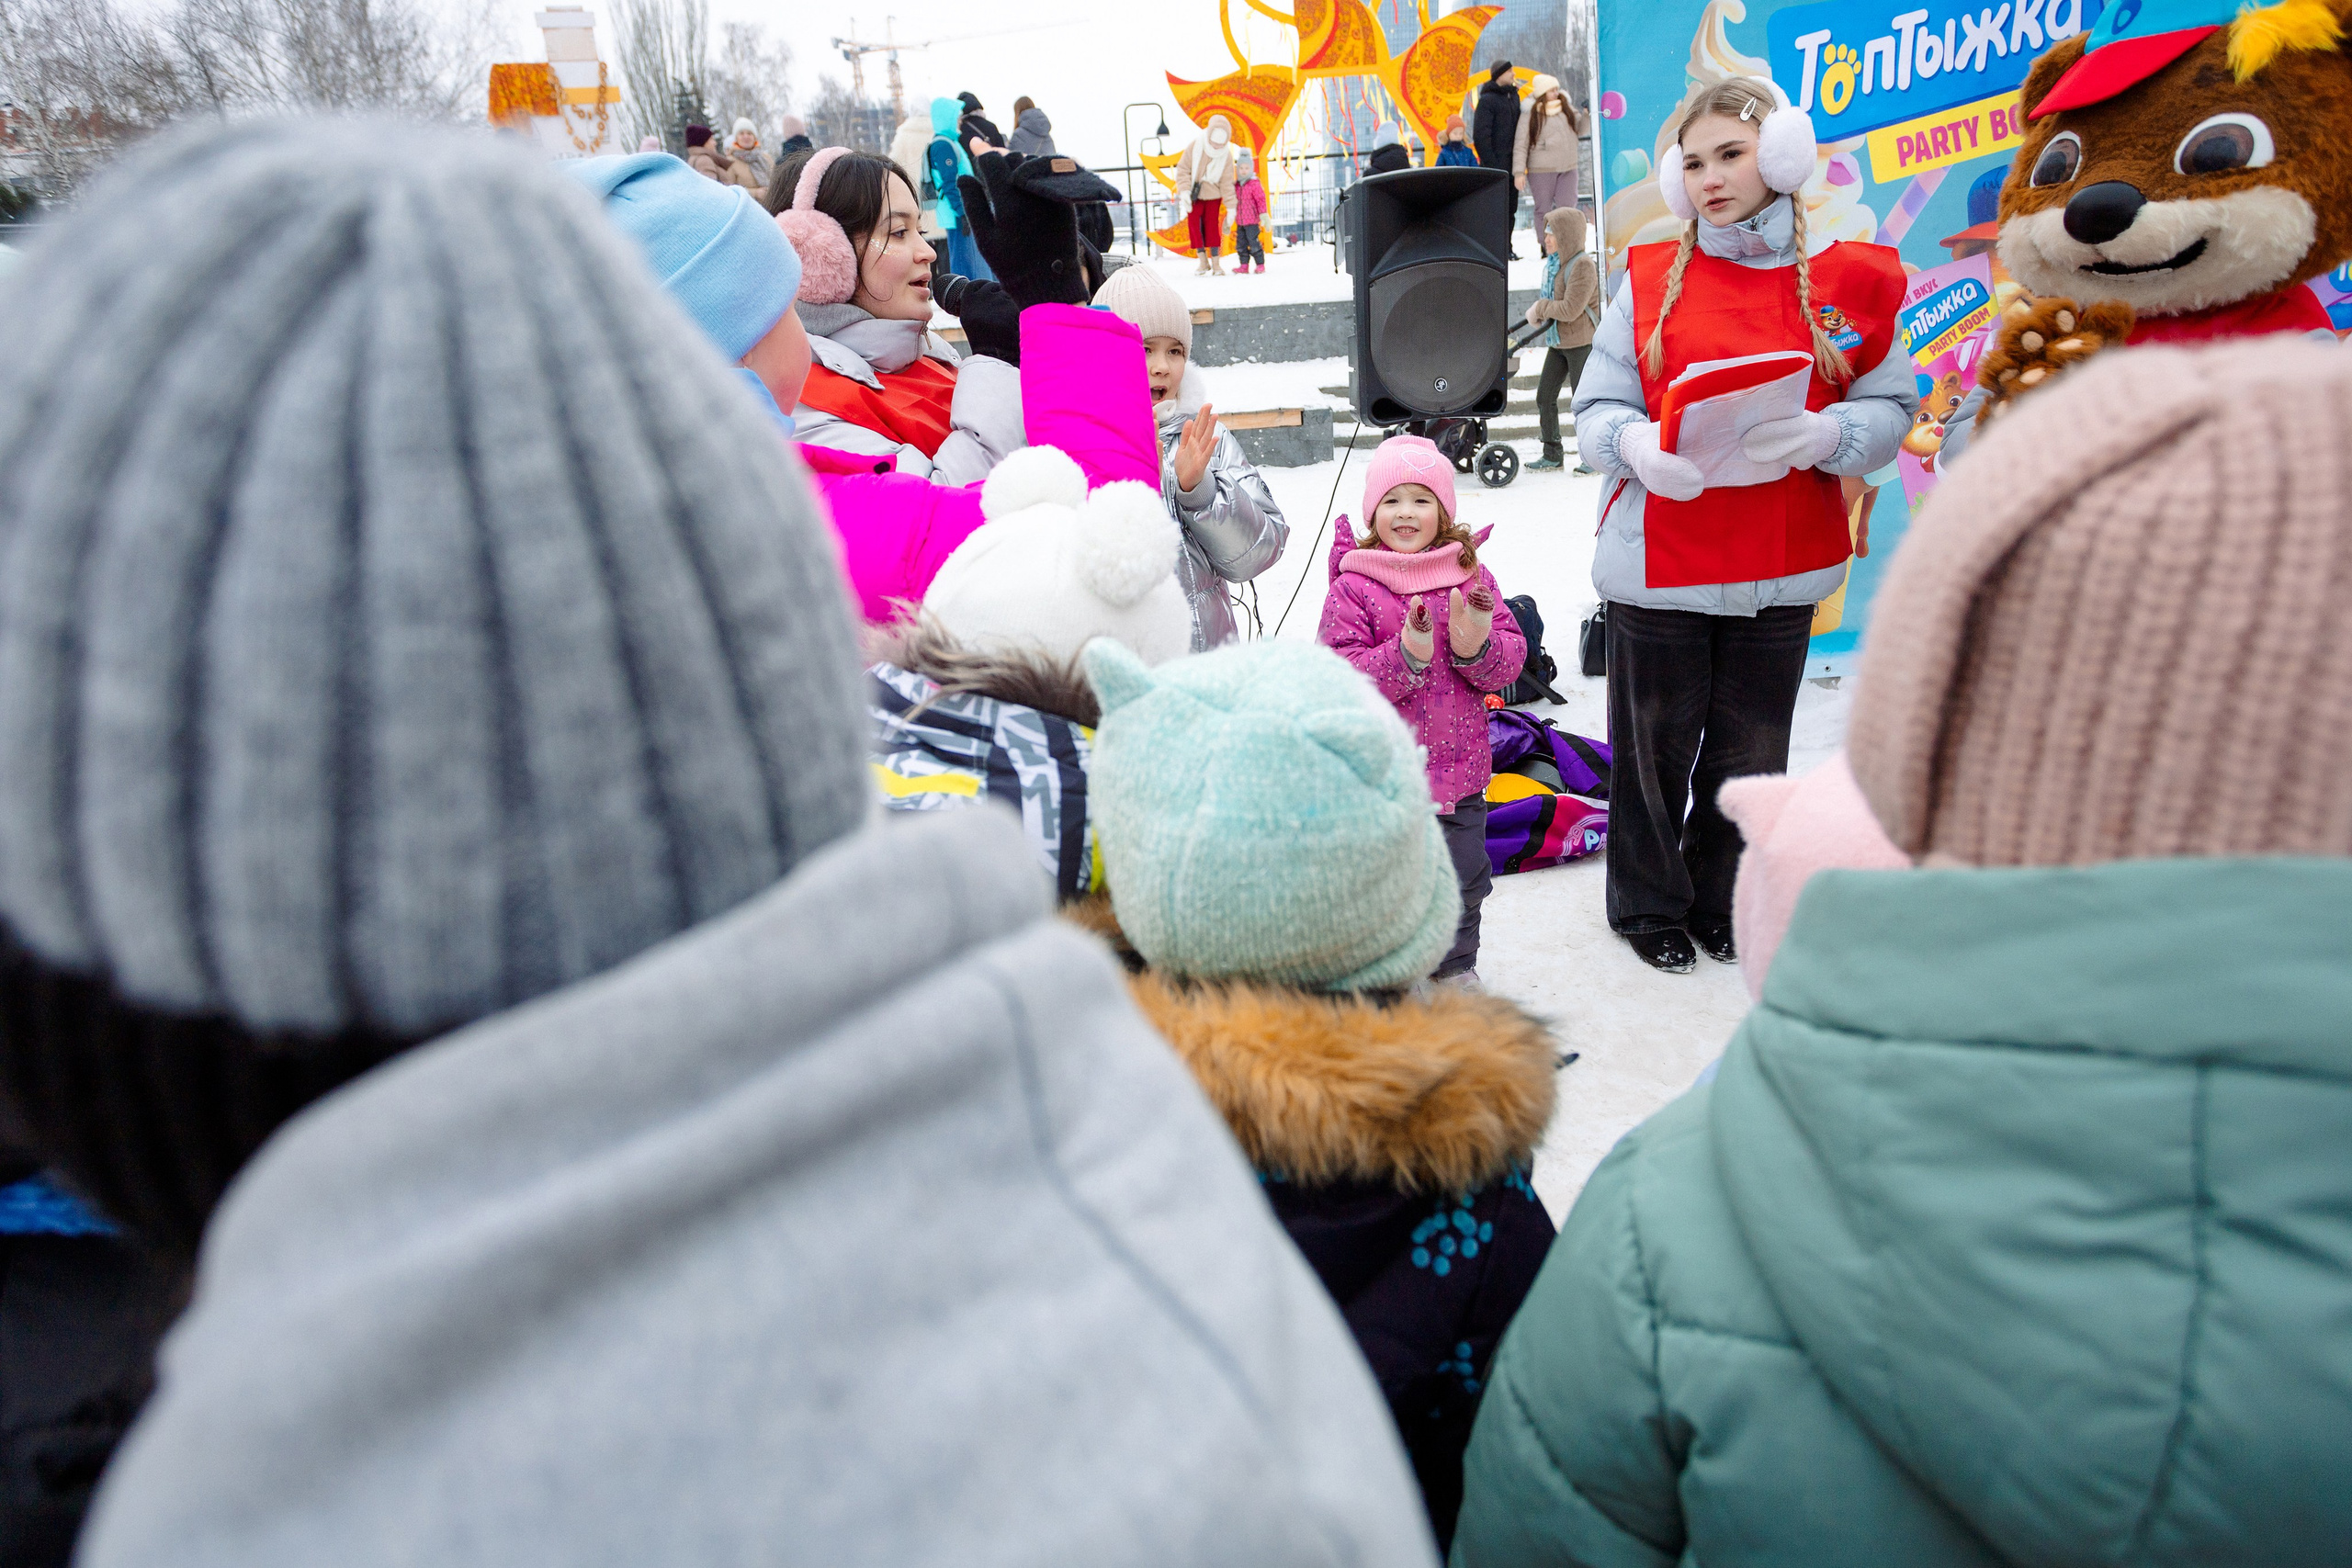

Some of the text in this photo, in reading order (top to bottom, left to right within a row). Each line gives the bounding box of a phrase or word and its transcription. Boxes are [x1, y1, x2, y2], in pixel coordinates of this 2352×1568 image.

[1895, 102, 2022, 168] PARTY BO
[1928, 307, 1992, 357] PARTY BOOM
